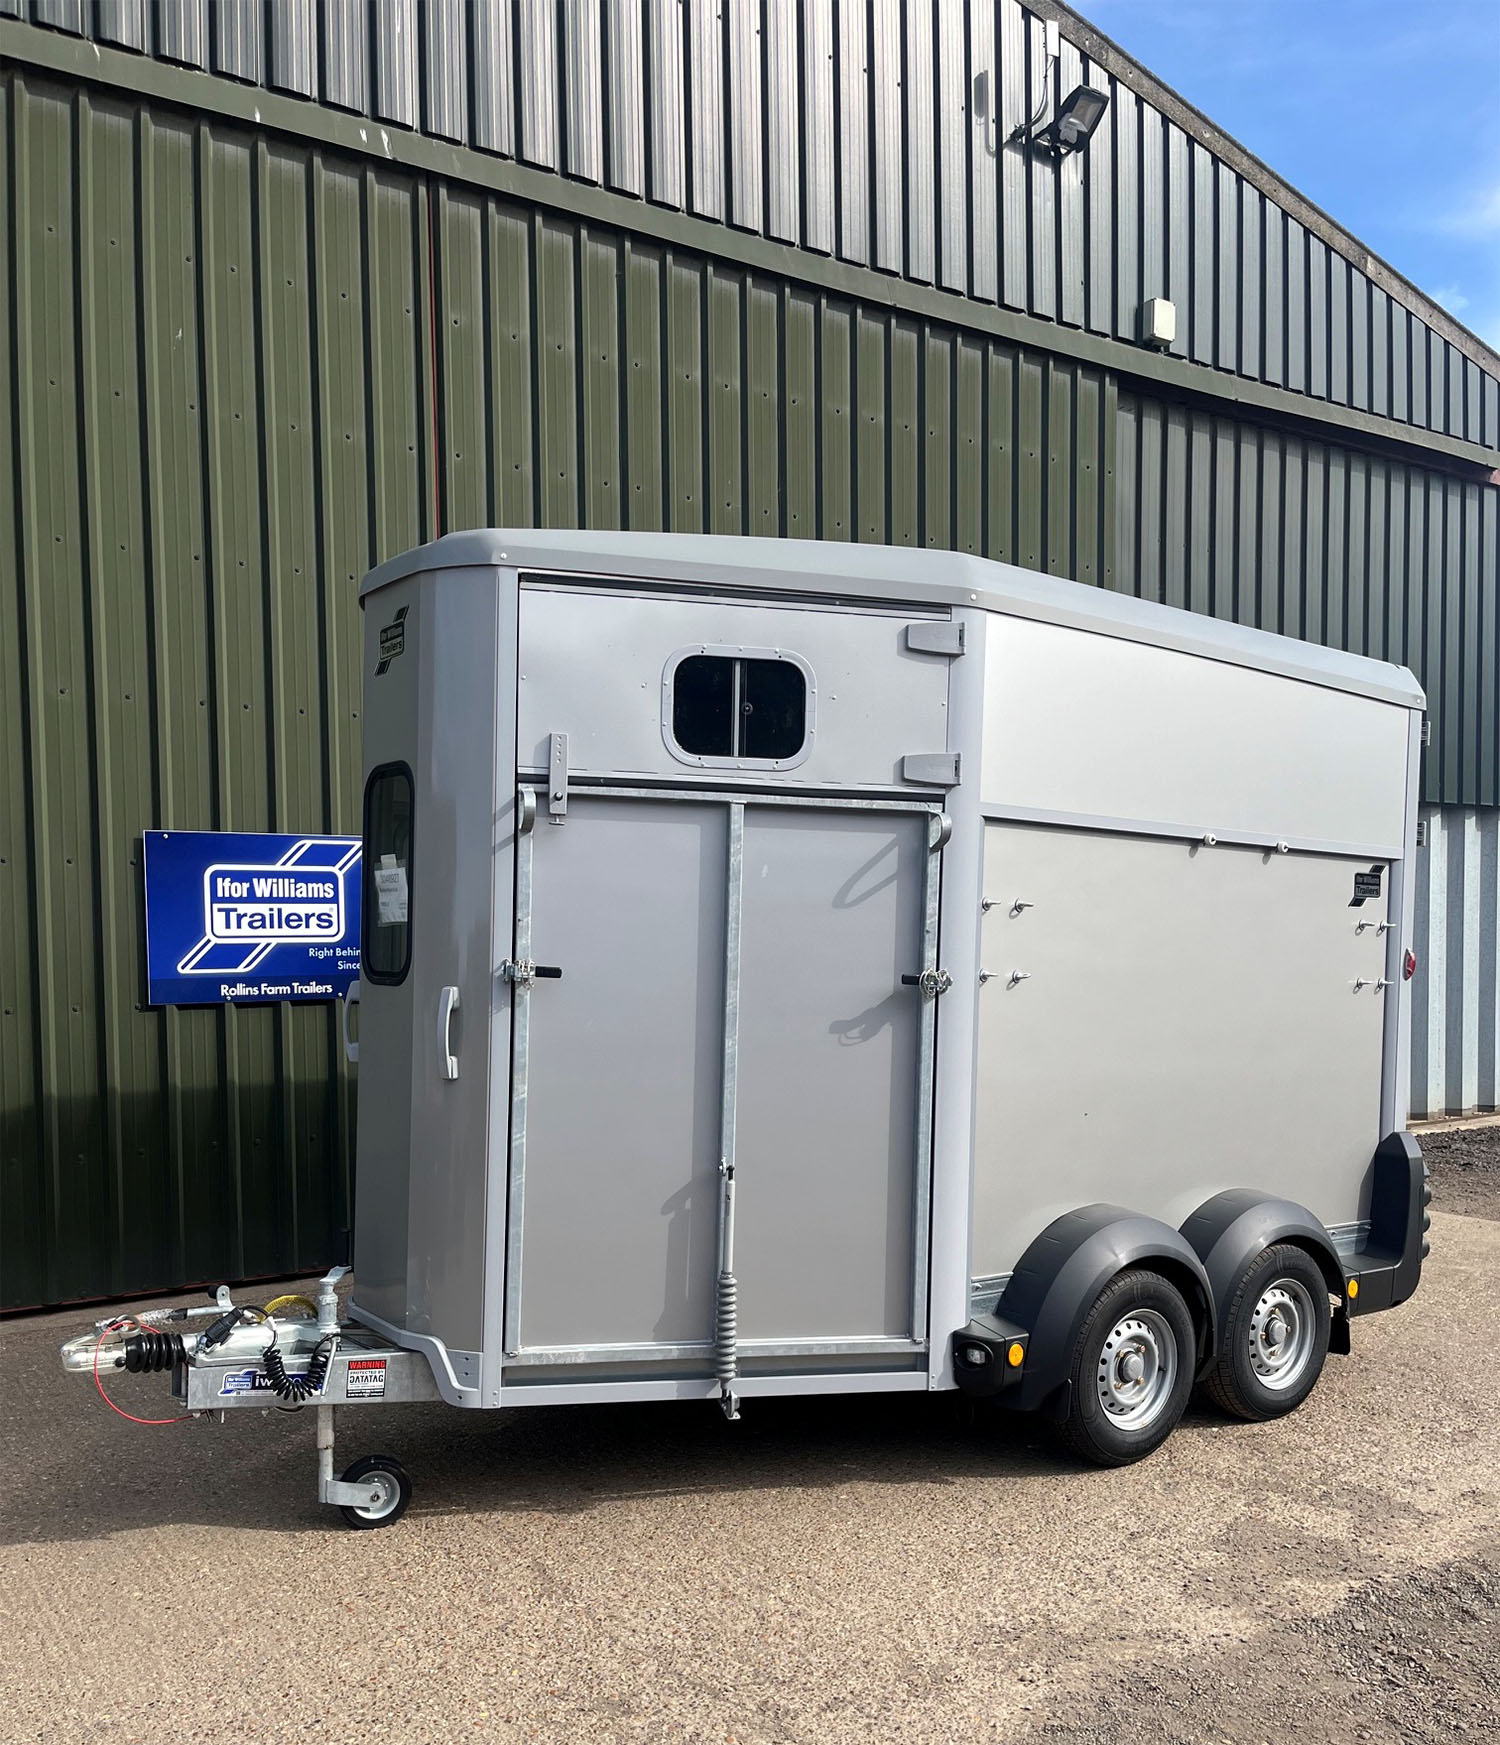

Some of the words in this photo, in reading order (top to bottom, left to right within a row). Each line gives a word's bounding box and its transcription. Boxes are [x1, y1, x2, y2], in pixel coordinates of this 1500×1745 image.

[381, 640, 403, 657] Trailers
[216, 877, 250, 898] Ifor
[252, 878, 335, 898] Williams
[1356, 885, 1379, 895] Trailers
[217, 907, 334, 930] Trailers
[308, 947, 334, 959] Right
[337, 960, 361, 970] Since
[220, 982, 259, 996] Rollins
[260, 983, 291, 995] Farm
[291, 981, 333, 994] Trailers
[349, 1360, 386, 1370] WARNING
